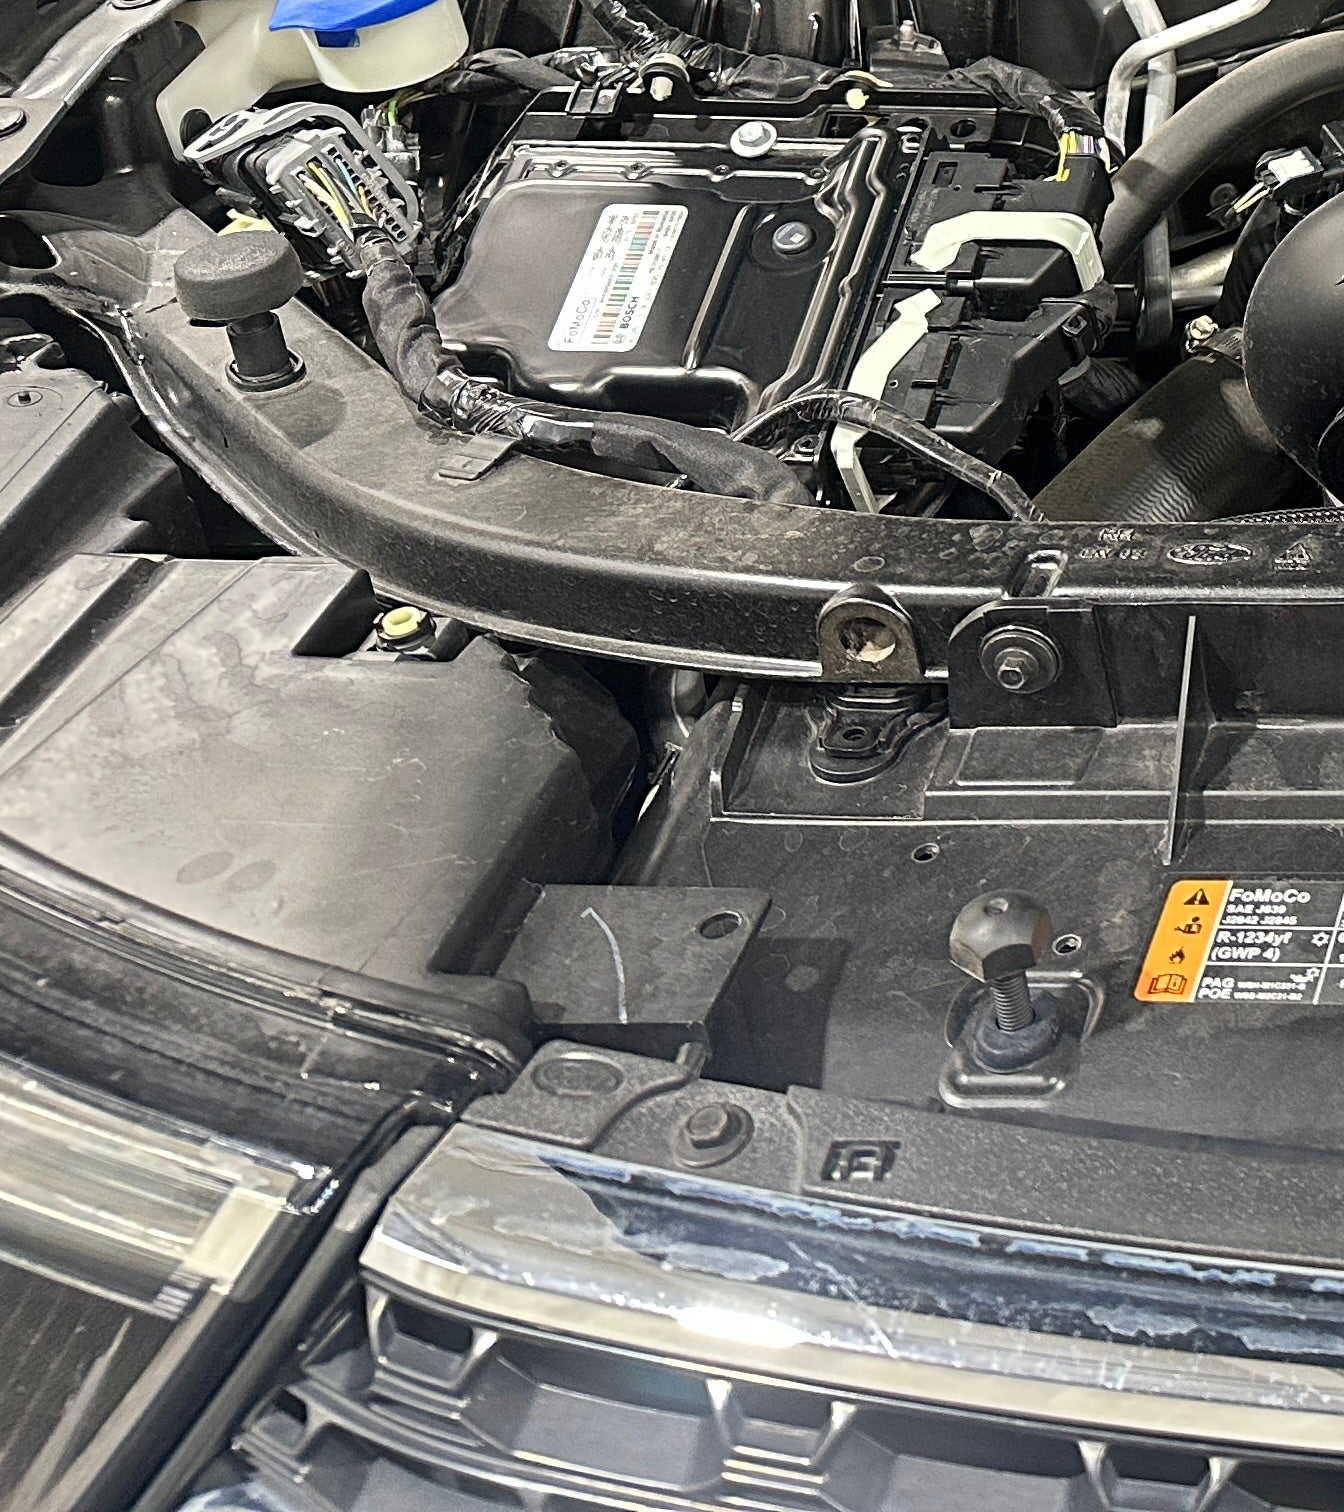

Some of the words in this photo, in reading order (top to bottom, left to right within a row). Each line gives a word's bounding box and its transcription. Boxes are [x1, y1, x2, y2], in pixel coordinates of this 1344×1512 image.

[619, 296, 640, 329] BOSCH
[1228, 888, 1311, 903] FoMoCo
[1216, 930, 1293, 946] R-1234yf
[1211, 947, 1261, 961] (GWP
[1262, 947, 1280, 962] 4)
[1201, 977, 1235, 988] PAG
[1197, 988, 1232, 999] POE
